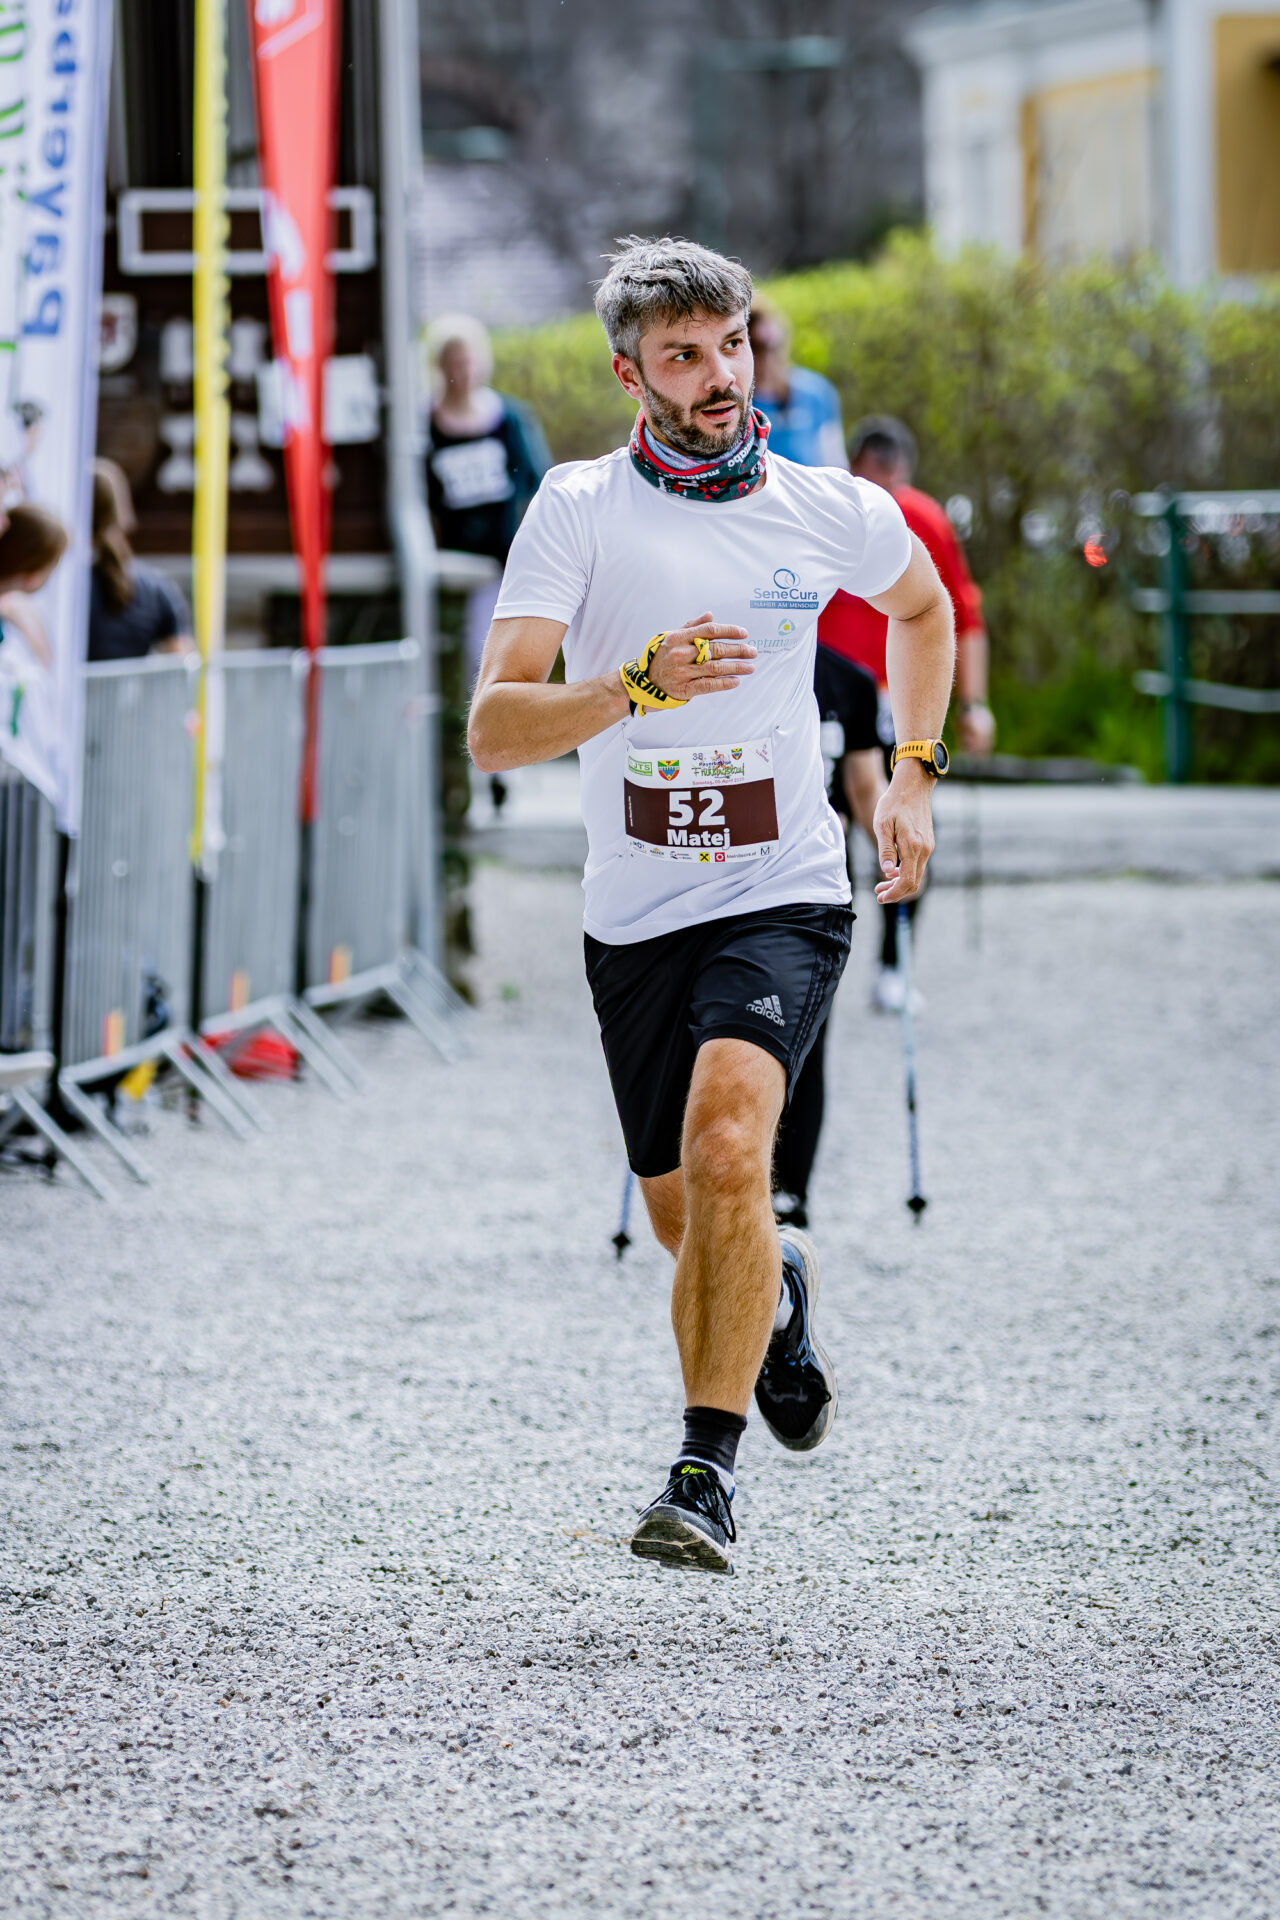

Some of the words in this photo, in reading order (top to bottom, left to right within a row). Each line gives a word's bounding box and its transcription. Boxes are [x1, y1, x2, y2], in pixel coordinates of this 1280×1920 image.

[753, 588, 818, 600] SeneCura
[778, 601, 788, 609] AM
[668, 788, 726, 827] 52
[666, 828, 731, 850] Matej
[745, 1003, 786, 1027] adidas
